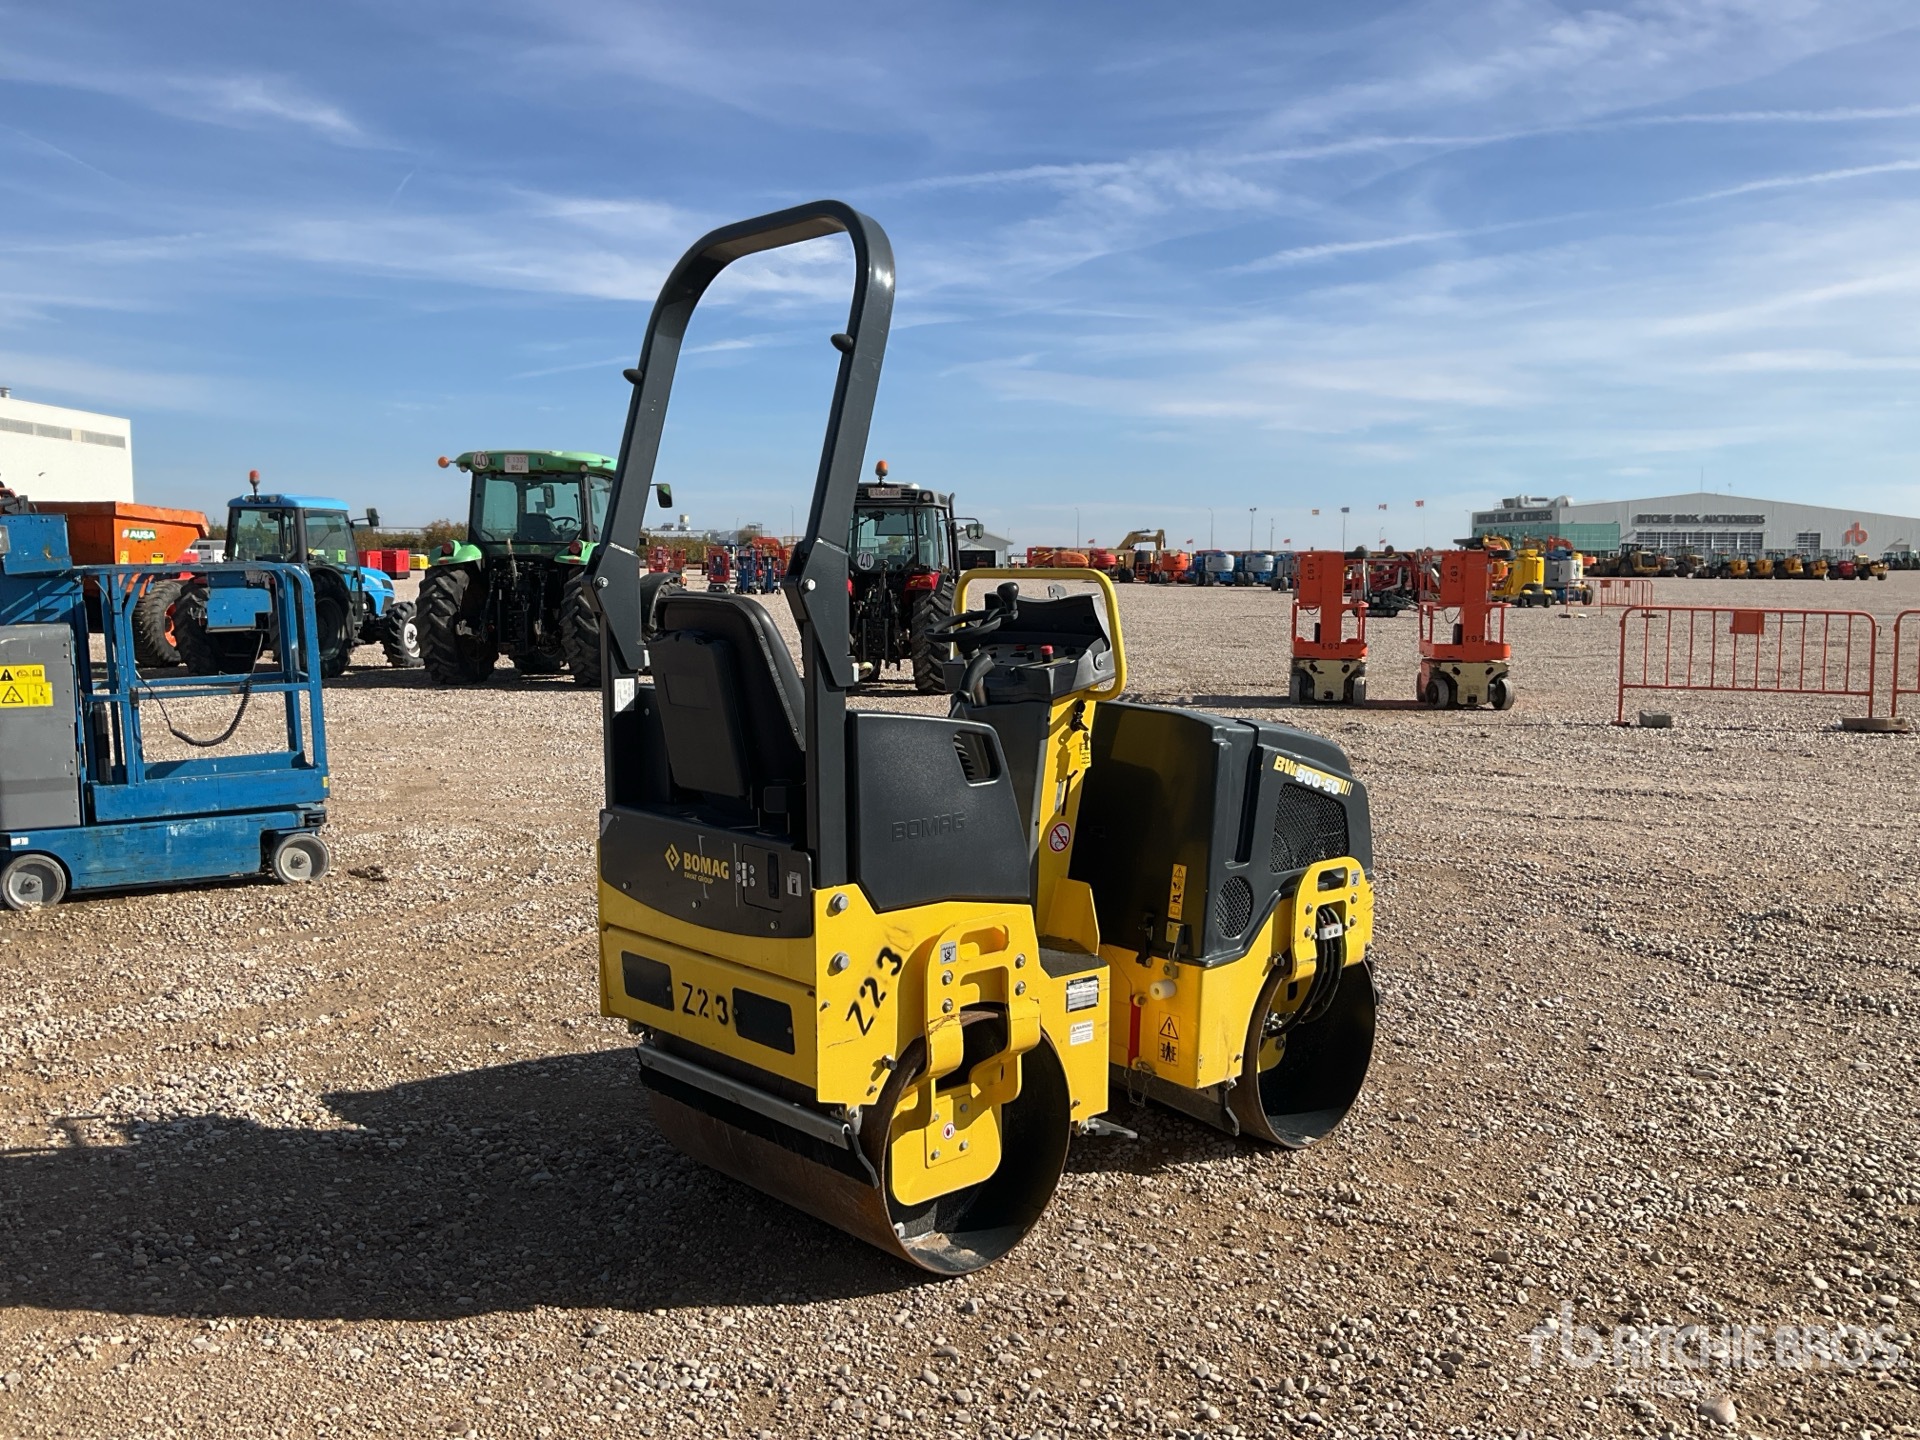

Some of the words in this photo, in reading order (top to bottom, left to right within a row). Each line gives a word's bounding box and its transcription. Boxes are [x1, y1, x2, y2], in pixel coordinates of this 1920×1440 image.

[475, 453, 487, 467] 40
[1636, 514, 1673, 524] RITCHIE
[1702, 514, 1766, 524] AUCTIONEERS
[129, 530, 156, 539] AUSA
[860, 553, 871, 568] 40
[891, 812, 966, 842] BOMAG
[683, 851, 730, 880] BOMAG
